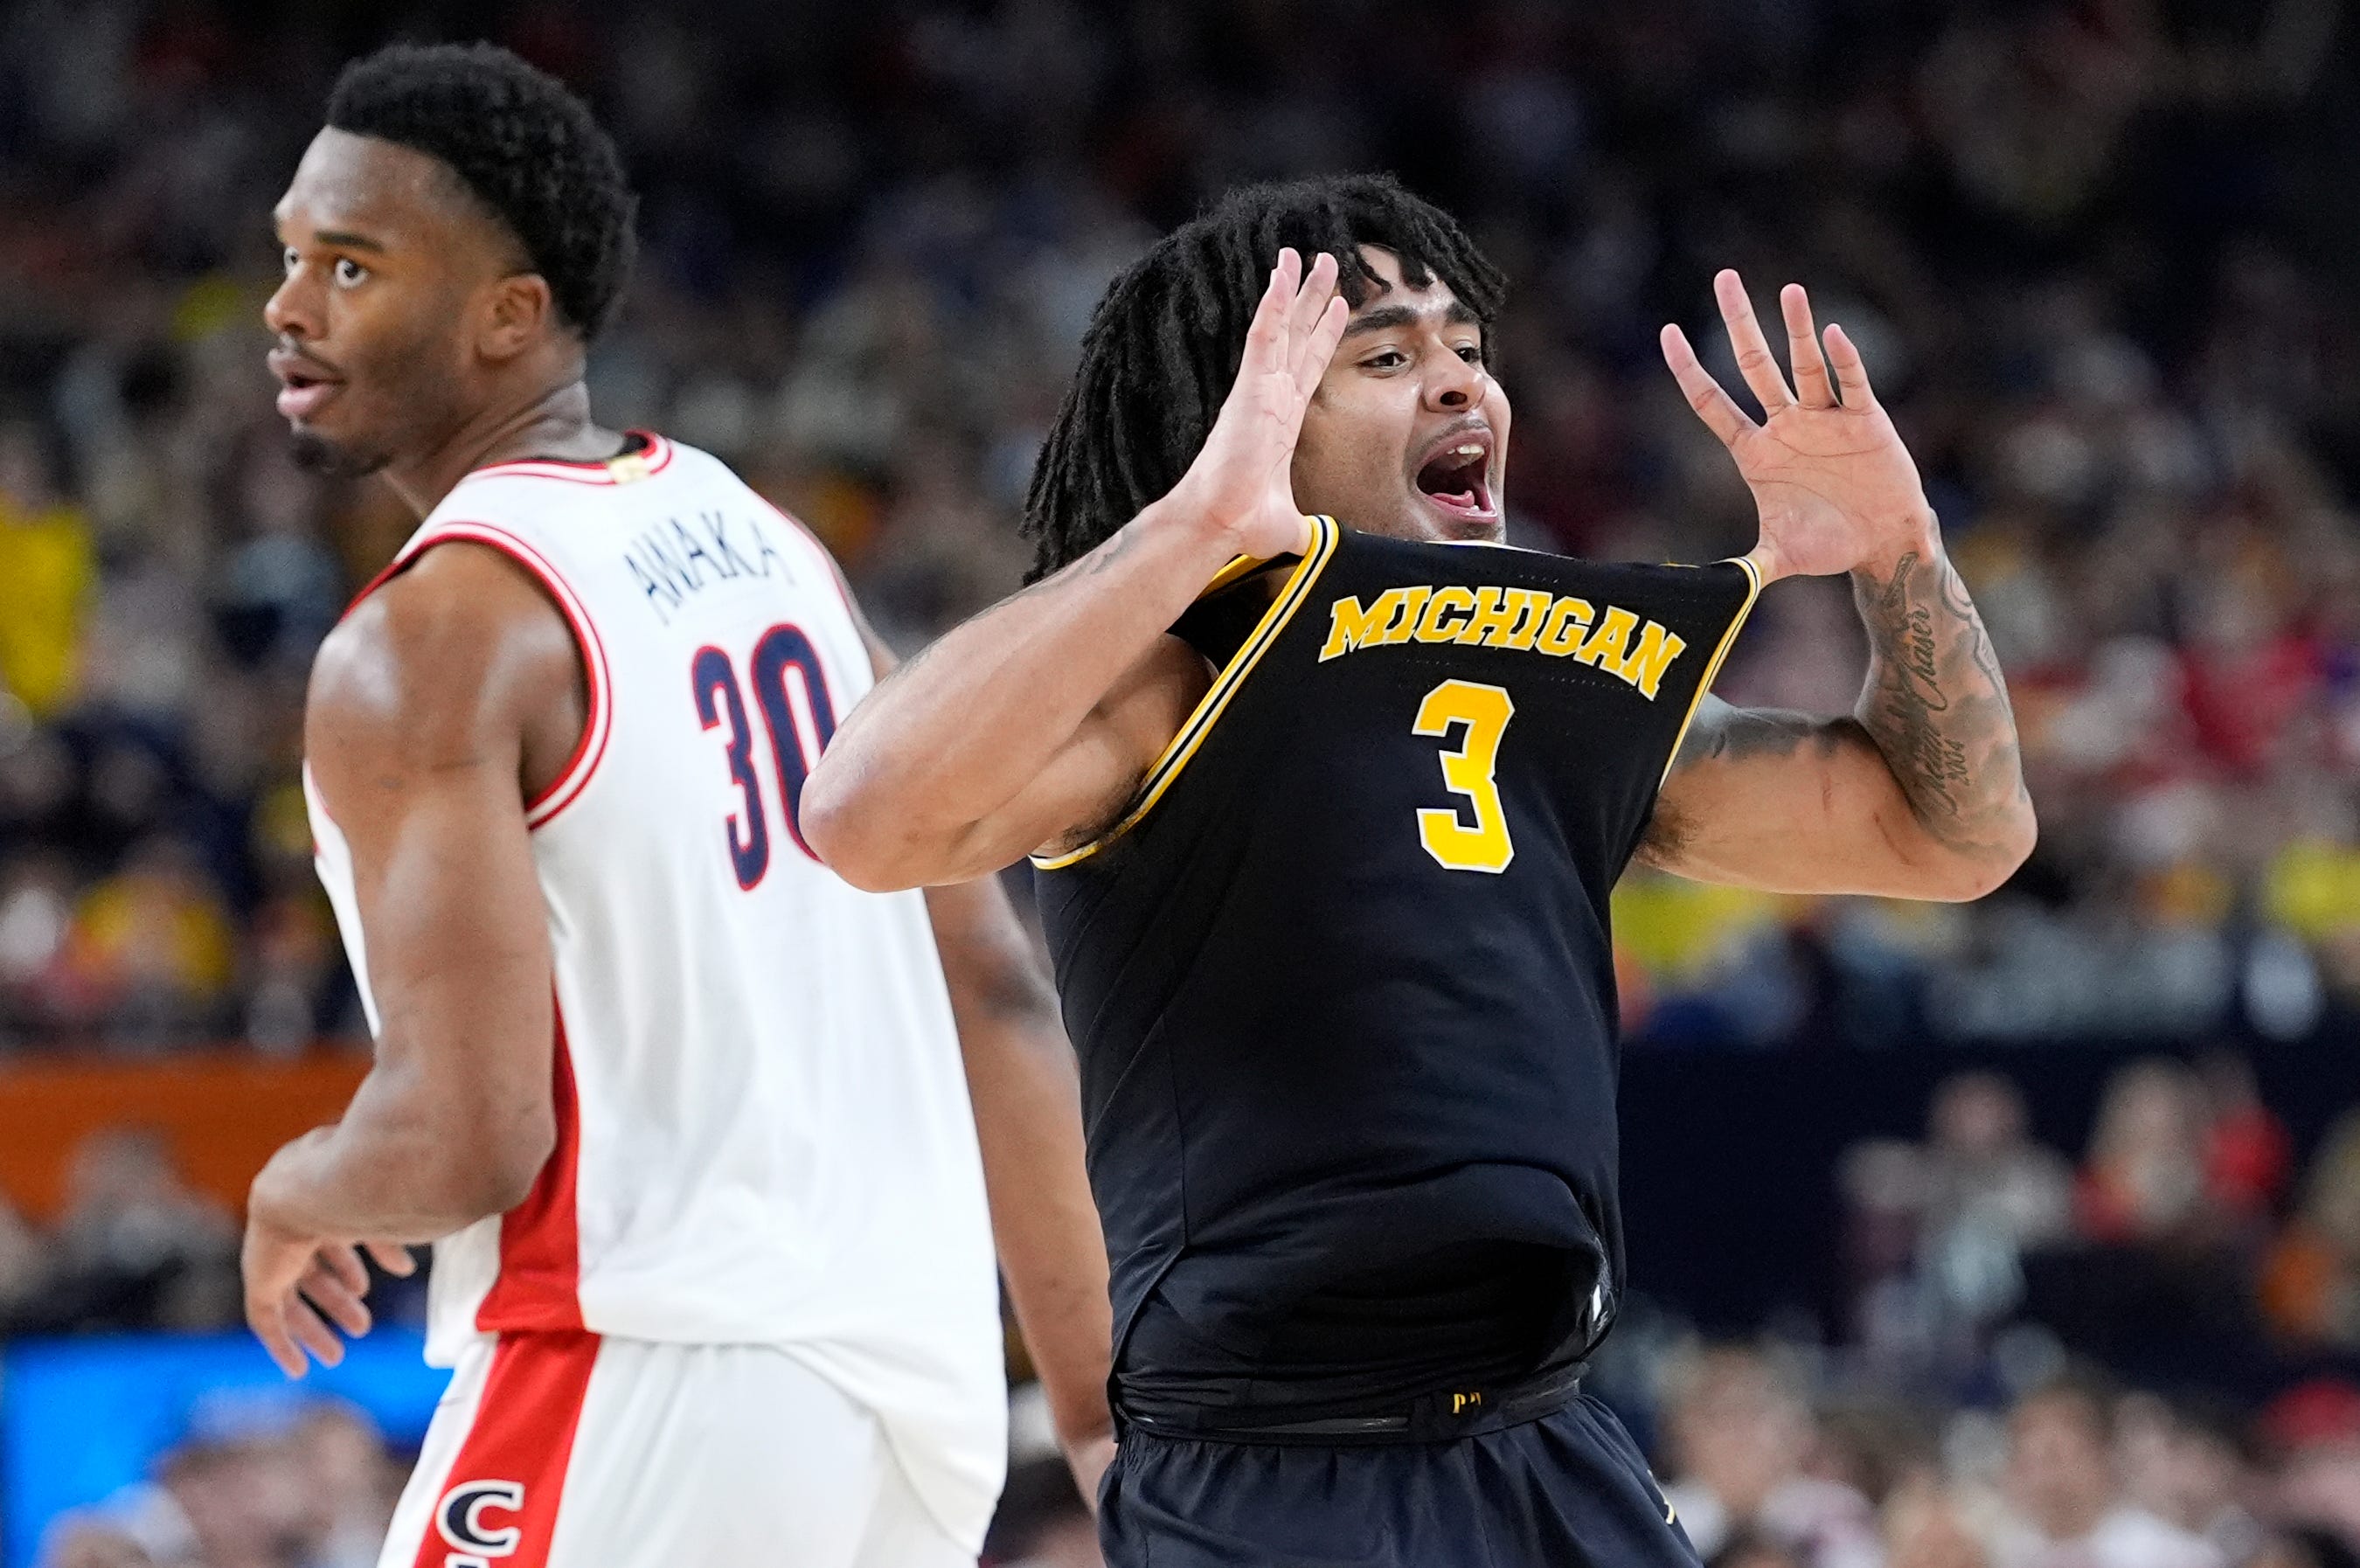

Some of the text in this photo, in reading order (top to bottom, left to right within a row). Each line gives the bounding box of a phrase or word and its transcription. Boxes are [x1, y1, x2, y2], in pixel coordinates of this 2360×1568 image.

[623, 510, 797, 628] AWAKA
[1318, 585, 1687, 702] MICHIGAN
[691, 622, 839, 892] 30
[1412, 678, 1516, 875] 3
